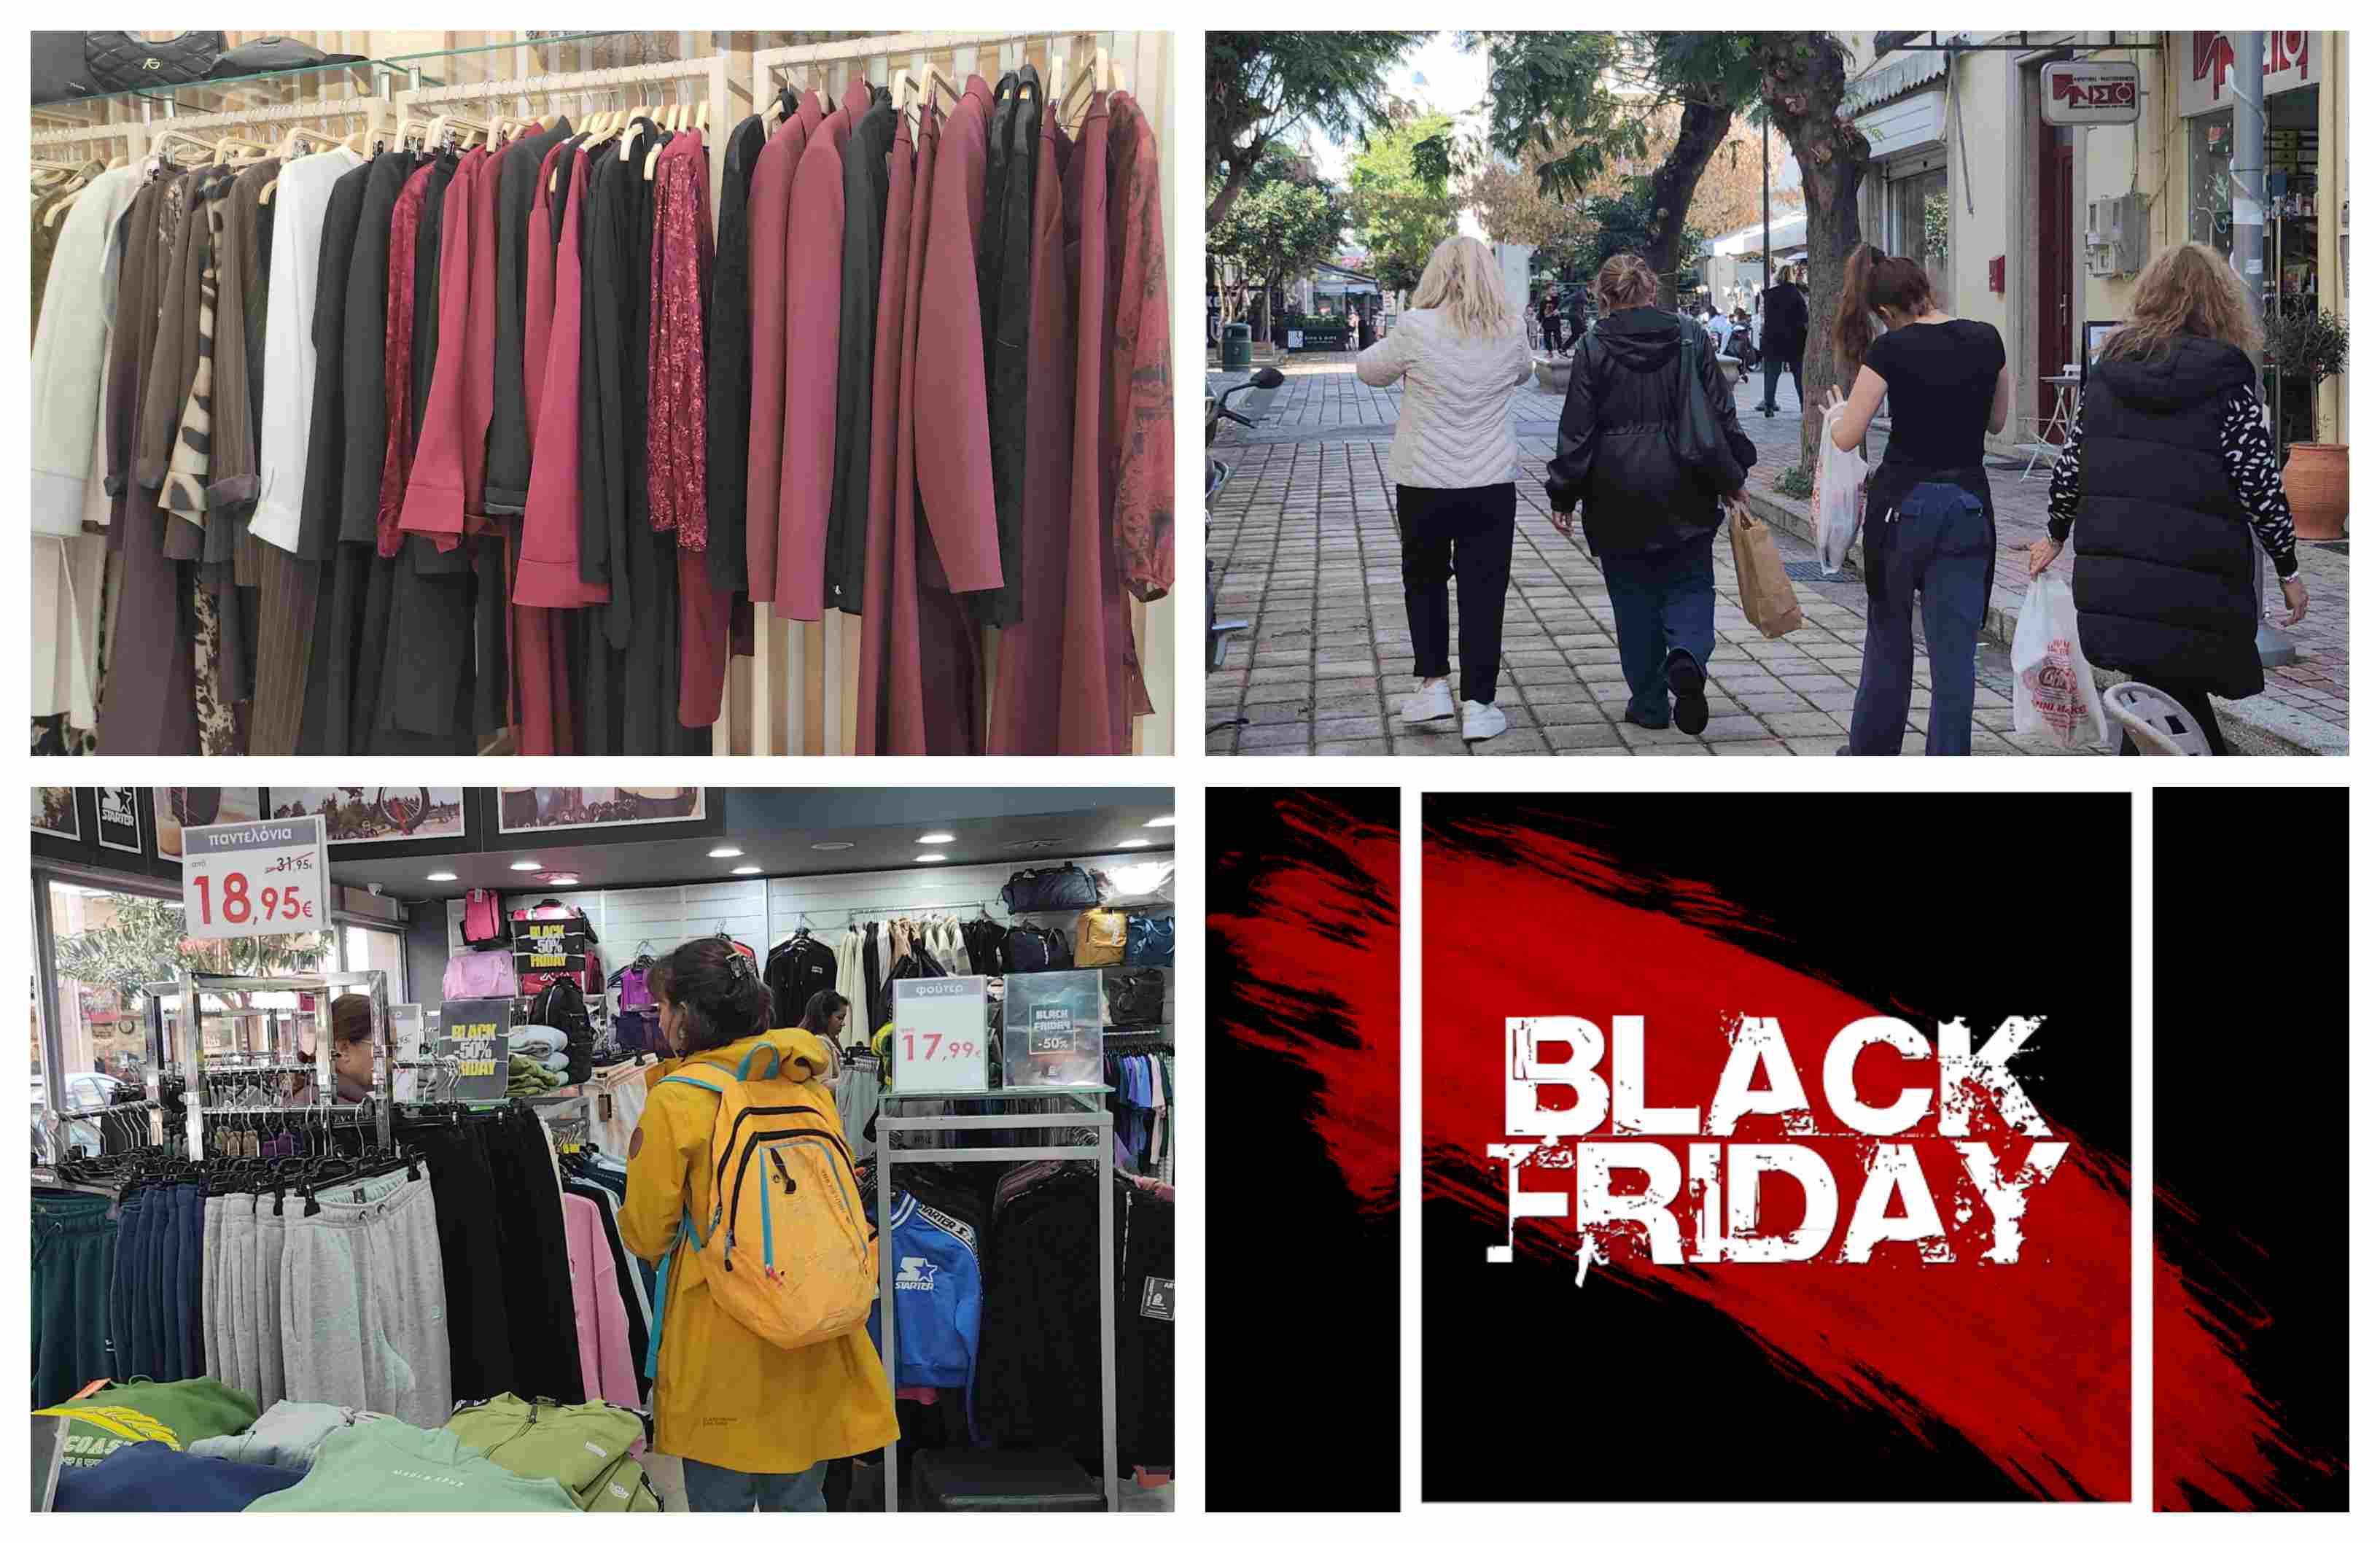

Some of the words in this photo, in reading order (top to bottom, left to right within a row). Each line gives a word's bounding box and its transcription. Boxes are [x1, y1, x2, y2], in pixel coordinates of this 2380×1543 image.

[208, 825, 292, 847] παντελόνια
[529, 924, 566, 940] BLACK
[530, 953, 567, 968] FRIDAY
[915, 982, 963, 998] φούτερ
[451, 1024, 497, 1042] BLACK
[1038, 1037, 1068, 1049] -50%
[1504, 1014, 2054, 1137] BLACK
[1486, 1142, 2070, 1287] FRIDAY
[894, 1282, 934, 1291] STARTER
